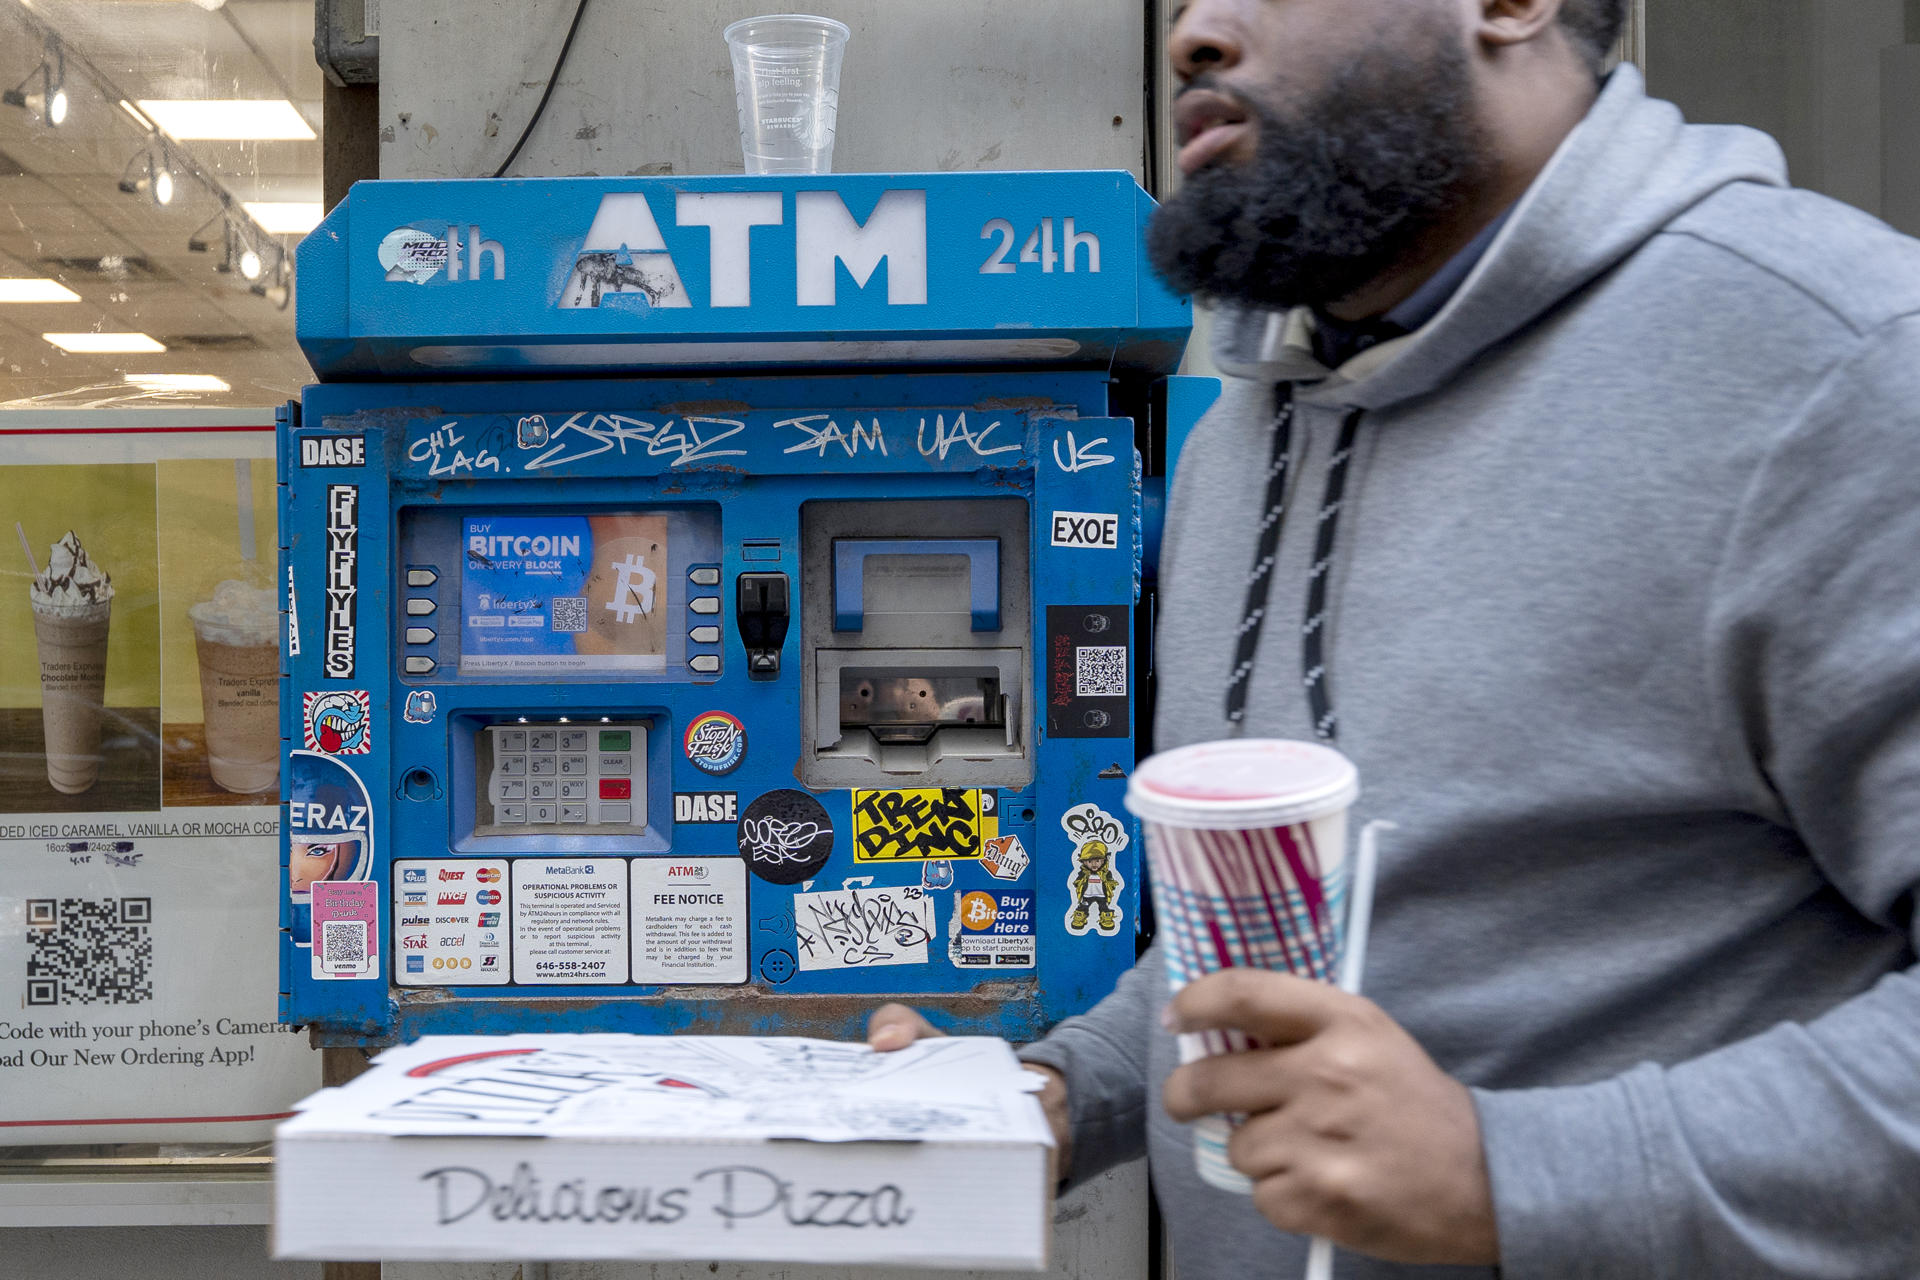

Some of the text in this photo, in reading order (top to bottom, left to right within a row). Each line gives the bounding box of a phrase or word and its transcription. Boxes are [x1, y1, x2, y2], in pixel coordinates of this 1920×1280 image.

[557, 190, 927, 308] ATM
[979, 217, 1100, 273] 24h
[408, 421, 465, 462] CHI
[302, 439, 365, 466] DASE
[470, 524, 491, 533] BUY
[1053, 516, 1116, 545] EXOE
[469, 535, 580, 557] BITCOIN
[525, 561, 562, 569] BLOCK
[502, 738, 507, 748] 1
[532, 738, 539, 748] 2
[562, 738, 570, 748] 3
[688, 737, 732, 760] Frisk
[502, 762, 510, 772] 4
[532, 762, 540, 772] 5
[562, 762, 570, 772] 6
[502, 786, 509, 796] 7
[532, 786, 540, 796] 8
[562, 786, 570, 796] 9
[540, 808, 546, 818] 0
[675, 795, 737, 822] DASE
[29, 825, 58, 838] ICED
[61, 824, 124, 838] CARAMEL,
[127, 823, 179, 836] VANILLA
[182, 823, 201, 835] OR
[204, 822, 250, 835] MOCHA
[545, 865, 585, 875] MetaBank
[668, 866, 694, 876] ATM
[522, 883, 570, 891] OPERATIONAL
[440, 892, 465, 900] NYCE
[534, 890, 606, 901] SUSPICIOUS ACTIVITY
[903, 887, 922, 900] 23
[325, 899, 366, 909] Birthday
[654, 894, 724, 905] FEE NOTICE
[1001, 896, 1029, 910] Buy
[519, 902, 532, 911] This
[560, 902, 586, 910] operated
[585, 902, 597, 911] and
[596, 901, 621, 911] Serviced
[527, 909, 562, 917] ATM24hours
[402, 915, 430, 926] pulse
[530, 918, 560, 926] regulatory
[674, 916, 687, 924] may
[688, 915, 708, 923] charge
[537, 924, 554, 932] event
[562, 924, 594, 933] operational
[684, 922, 693, 930] for
[699, 922, 713, 930] each
[994, 922, 1029, 933] Here
[600, 933, 622, 941] activity
[691, 930, 700, 938] fee
[403, 939, 429, 949] STAR
[440, 933, 465, 947] accel
[997, 937, 1029, 945] LibertyX
[584, 947, 604, 955] service
[676, 954, 701, 962] charged
[535, 960, 607, 970] 646-558-2407
[661, 960, 686, 968] Financial
[535, 970, 607, 978] www.atm24hrs.com
[0, 1017, 288, 1042] Code with your phone's Camera
[30, 1049, 68, 1067] Our
[74, 1048, 116, 1066] New
[121, 1047, 204, 1068] Ordering
[209, 1045, 255, 1067] App!
[419, 1160, 915, 1231] Delicious Pizza
